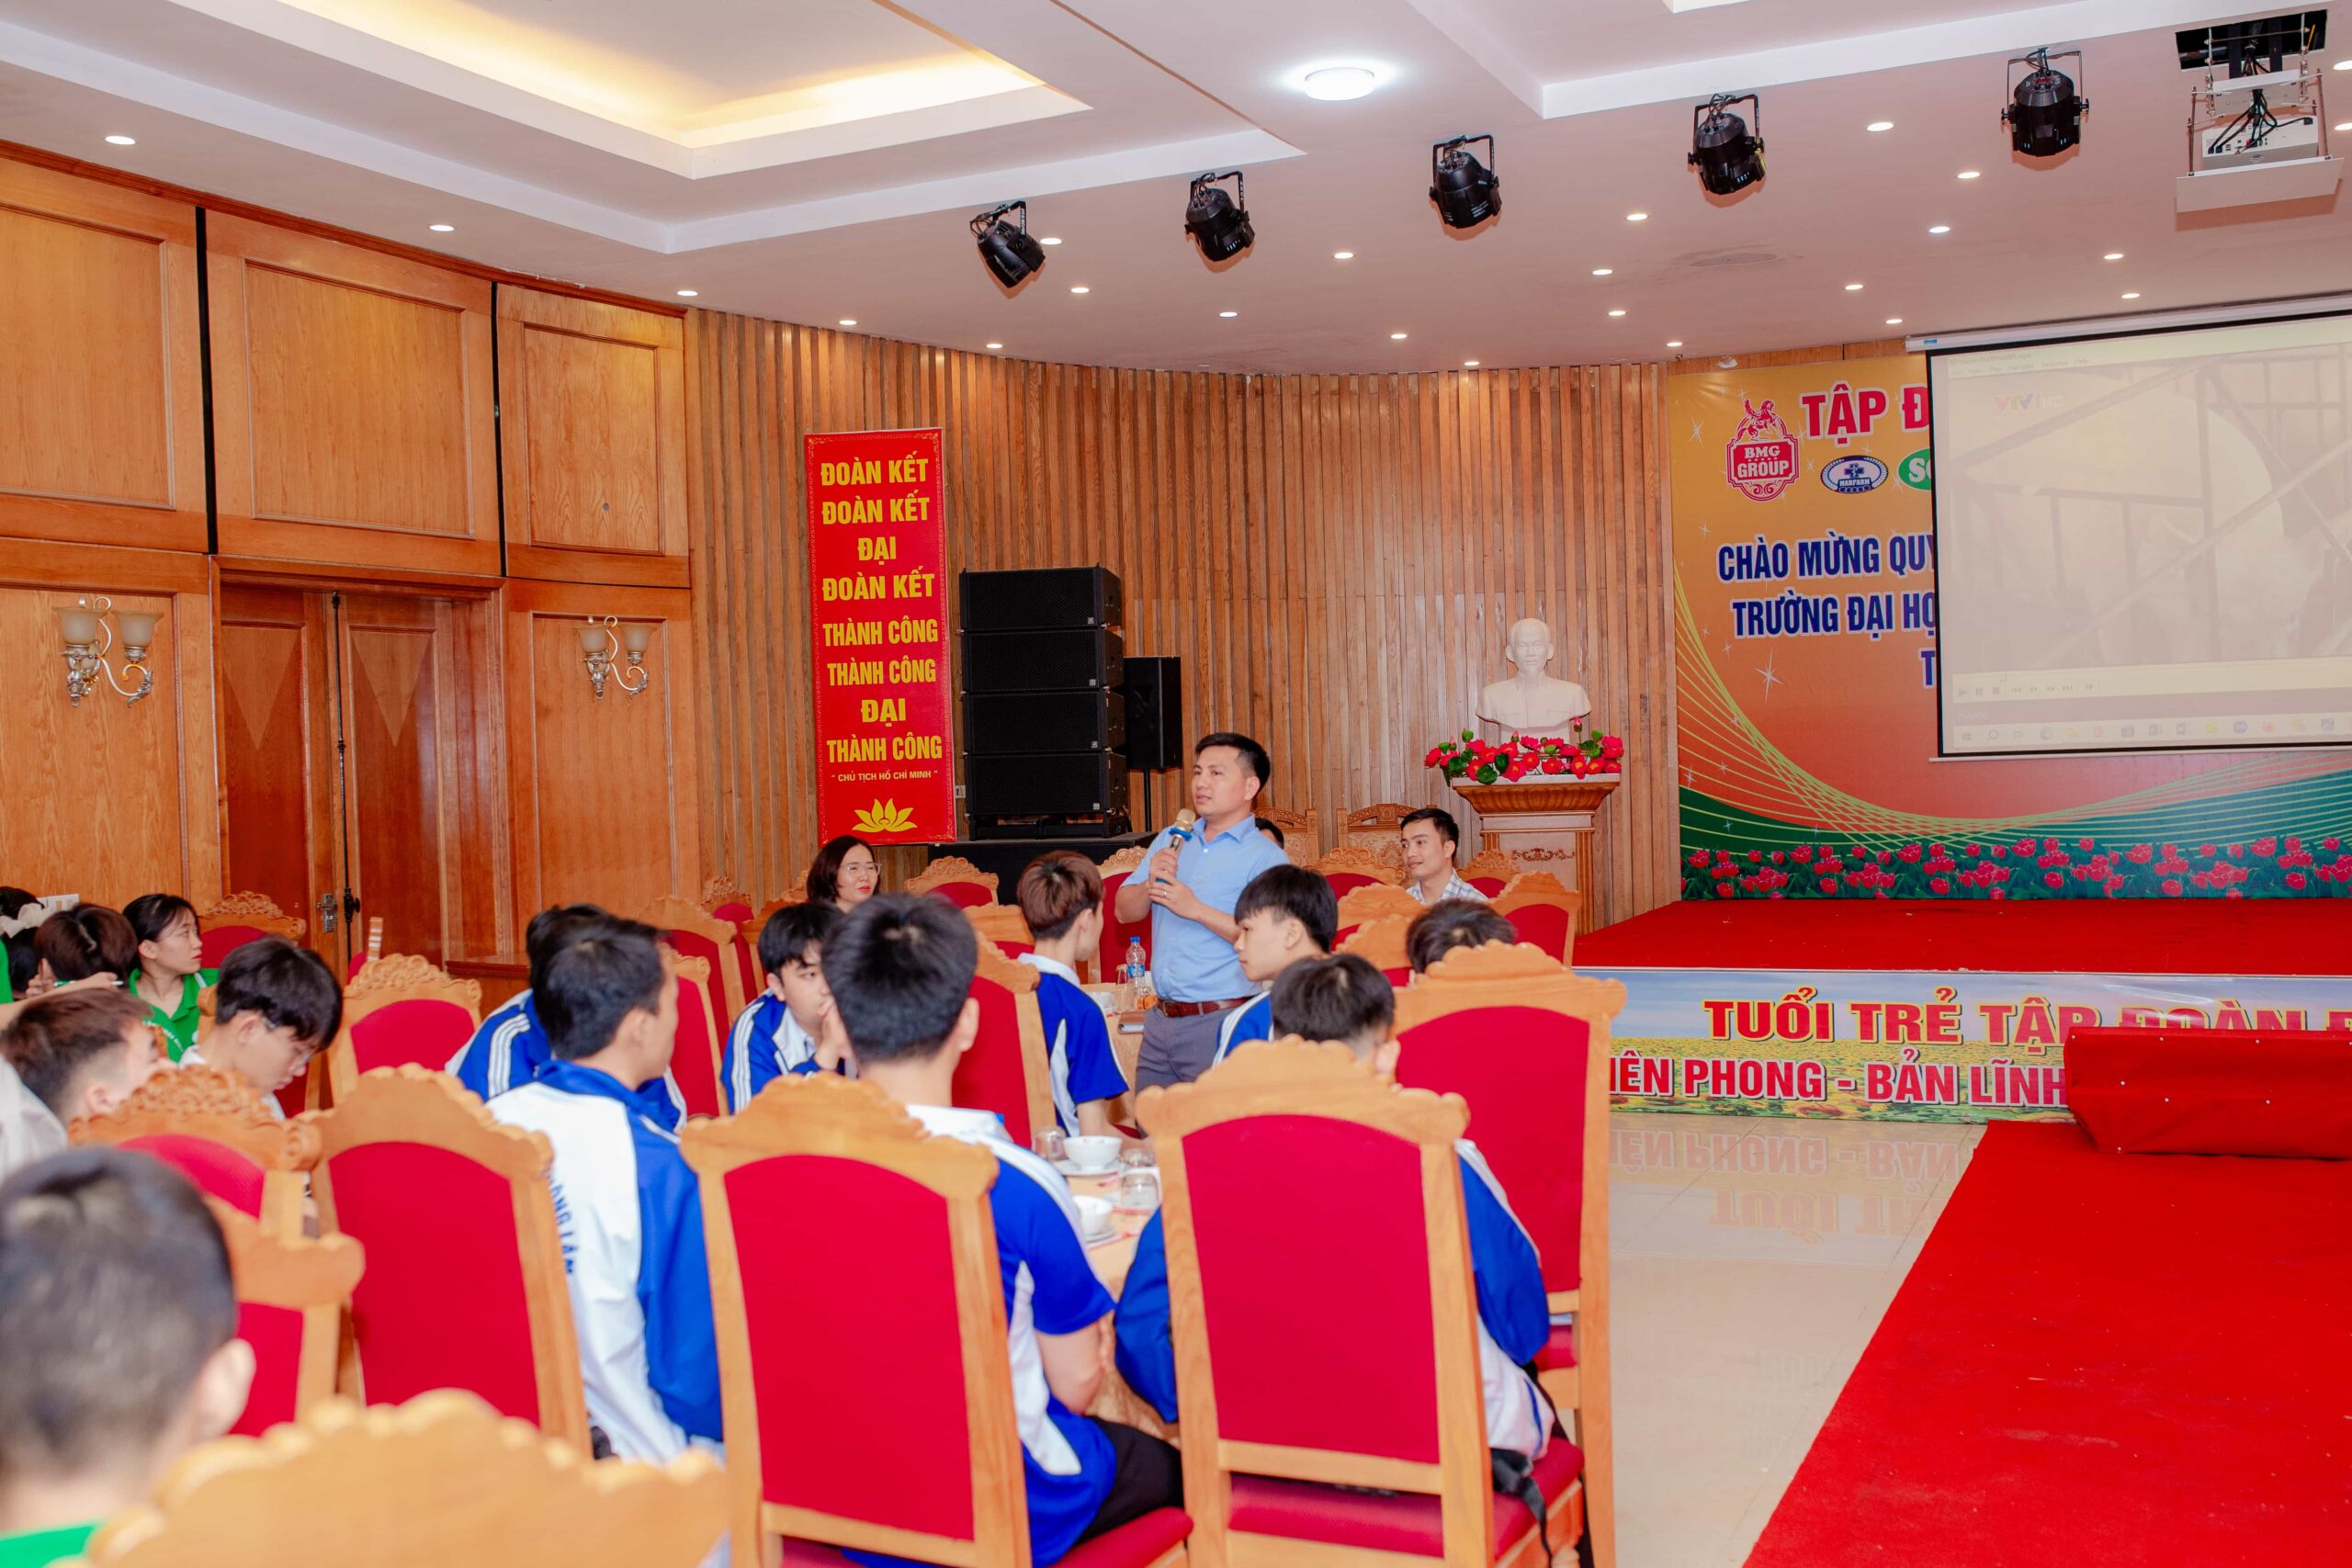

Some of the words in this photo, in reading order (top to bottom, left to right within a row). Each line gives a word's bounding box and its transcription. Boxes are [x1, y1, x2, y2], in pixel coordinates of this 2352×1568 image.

[1802, 382, 1886, 445] TẬP
[820, 457, 882, 486] ĐOÀN
[888, 450, 929, 483] KẾT
[1737, 459, 1789, 478] GROUP
[1744, 445, 1781, 458] BMG
[821, 495, 883, 525] ĐOÀN
[889, 489, 930, 523] KẾT
[857, 536, 897, 566] ĐẠI
[1719, 537, 1788, 581] CHÀO
[1798, 531, 1880, 577] MỪNG
[821, 571, 886, 602] ĐOÀN
[893, 565, 935, 599] KẾT
[822, 617, 883, 647] THÀNH
[888, 615, 939, 645] CÔNG
[1733, 590, 1838, 636] TRƯỜNG
[1848, 594, 1894, 638] ĐẠI
[827, 657, 884, 686] THÀNH
[888, 654, 936, 684] CÔNG
[861, 697, 907, 728] ĐẠI
[826, 733, 887, 763] THÀNH
[892, 732, 943, 761] CÔNG
[838, 771, 855, 782] CHỦ
[857, 773, 877, 783] TỊCH
[909, 771, 932, 779] MINH
[1703, 987, 1833, 1042] TUỔI
[1850, 987, 1962, 1043] TRẺ
[1980, 997, 2099, 1055] TẬP
[1684, 1059, 1825, 1100] PHONG
[1838, 1078, 1856, 1089] -
[1867, 1048, 1958, 1102] BẢN
[1970, 1058, 2068, 1106] LĨNH
